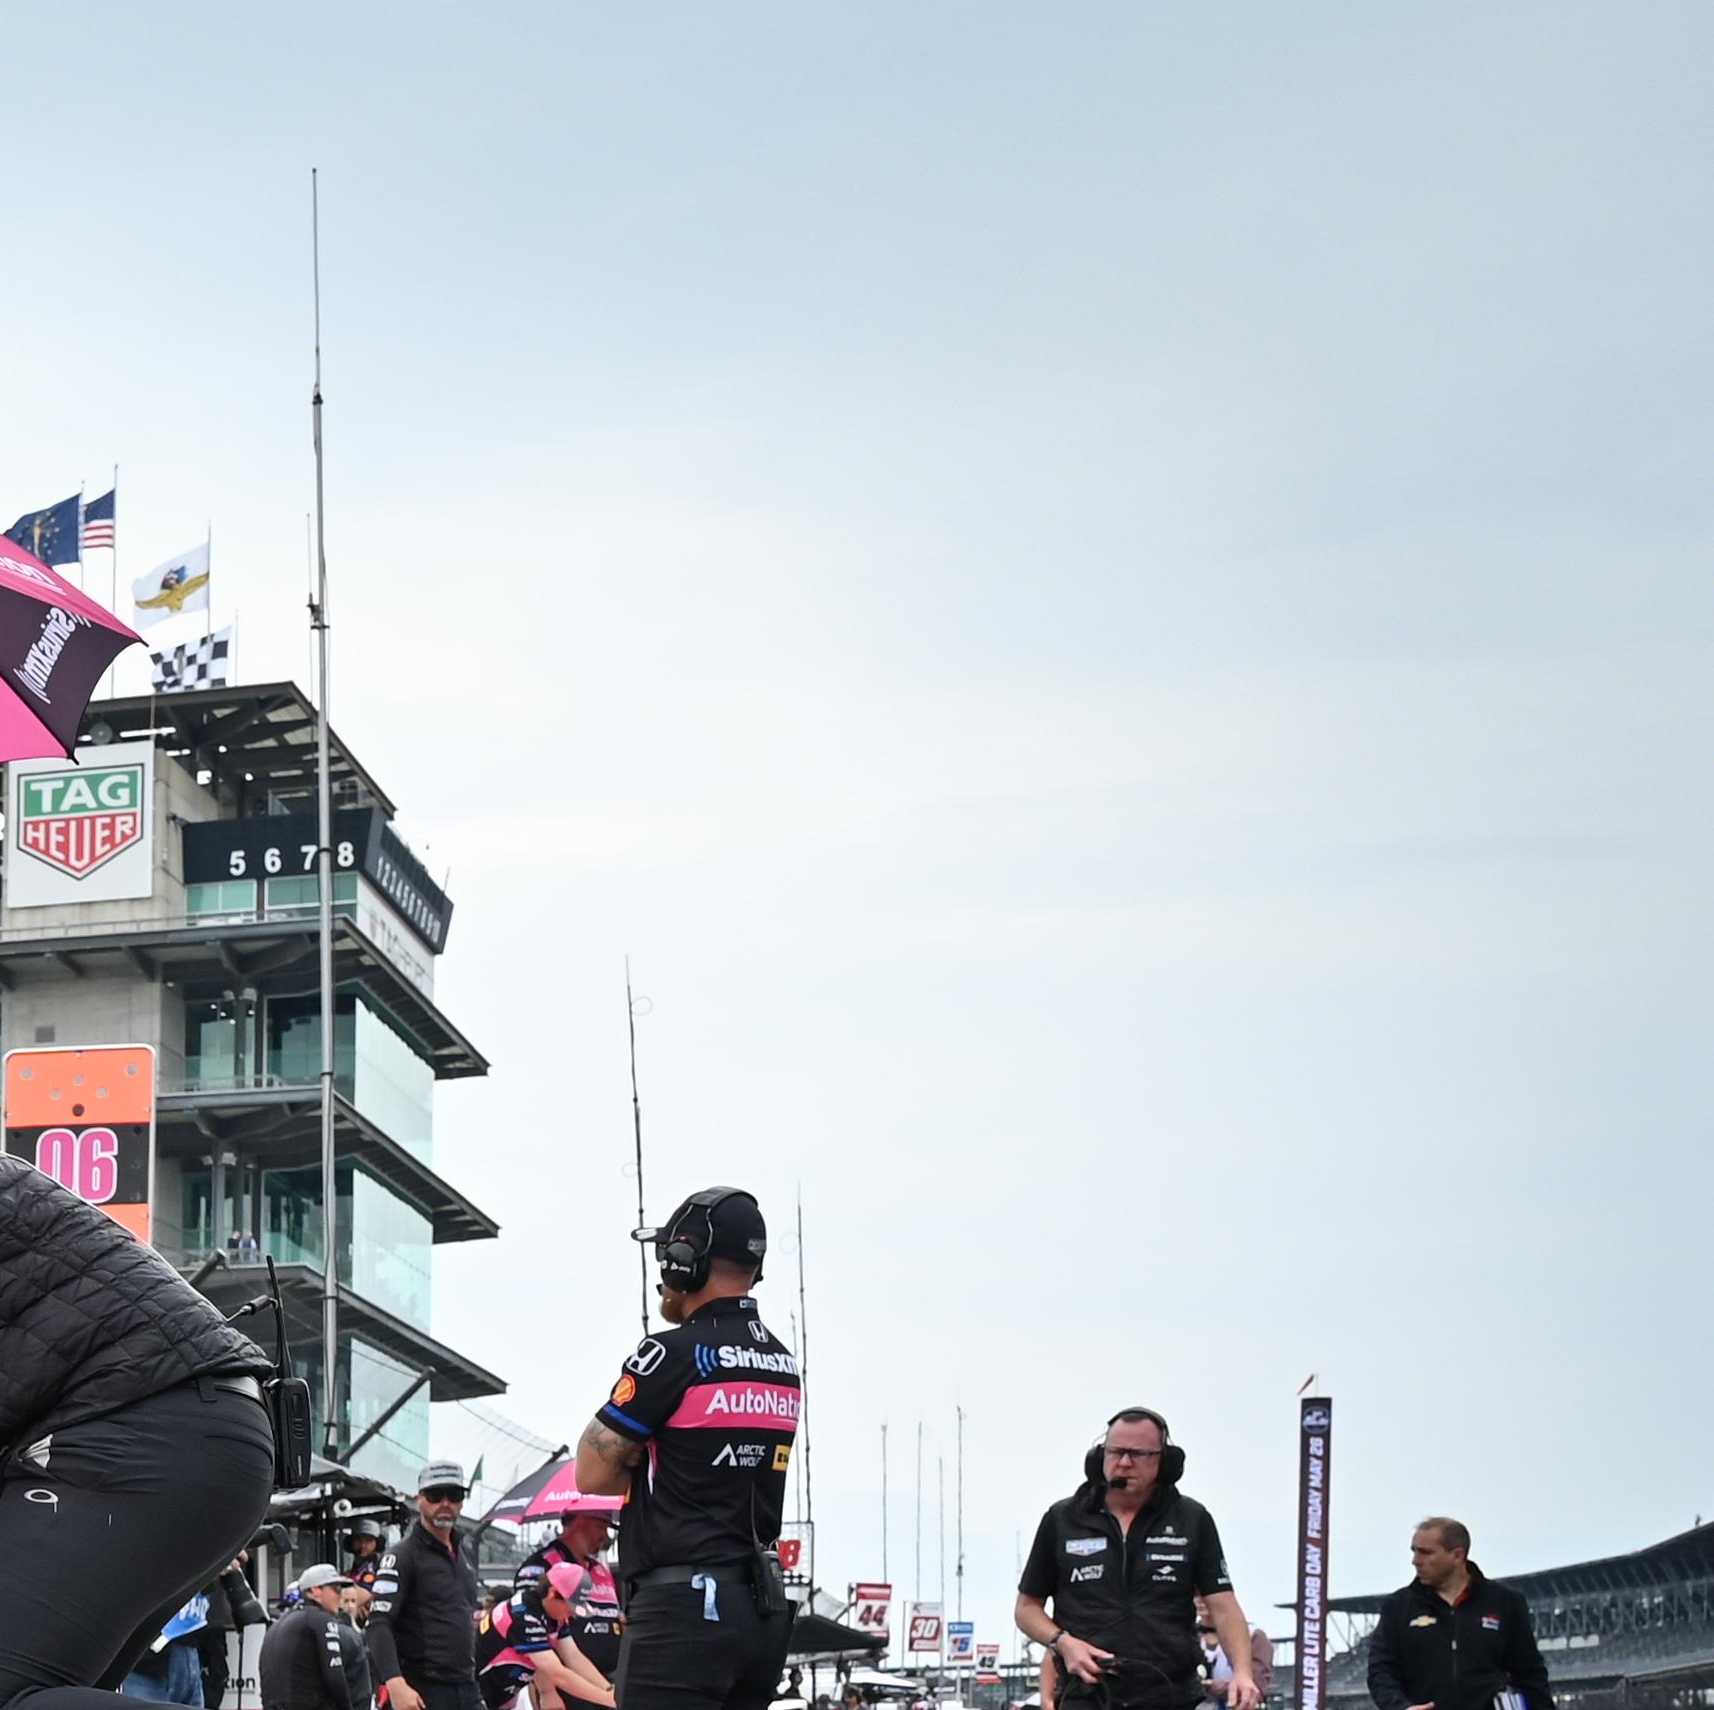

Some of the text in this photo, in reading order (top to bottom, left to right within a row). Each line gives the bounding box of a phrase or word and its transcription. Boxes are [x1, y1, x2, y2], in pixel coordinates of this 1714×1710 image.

[30, 774, 131, 813] TAG
[26, 815, 135, 869] HEUER
[228, 841, 355, 876] 5 6 7 8
[35, 1127, 119, 1205] 06
[1308, 1457, 1323, 1488] MAY
[1307, 1489, 1322, 1539] FRIDAY
[1305, 1543, 1322, 1576] DAY
[857, 1604, 888, 1627] 44
[911, 1618, 939, 1639] 30
[1303, 1619, 1320, 1655] LITE
